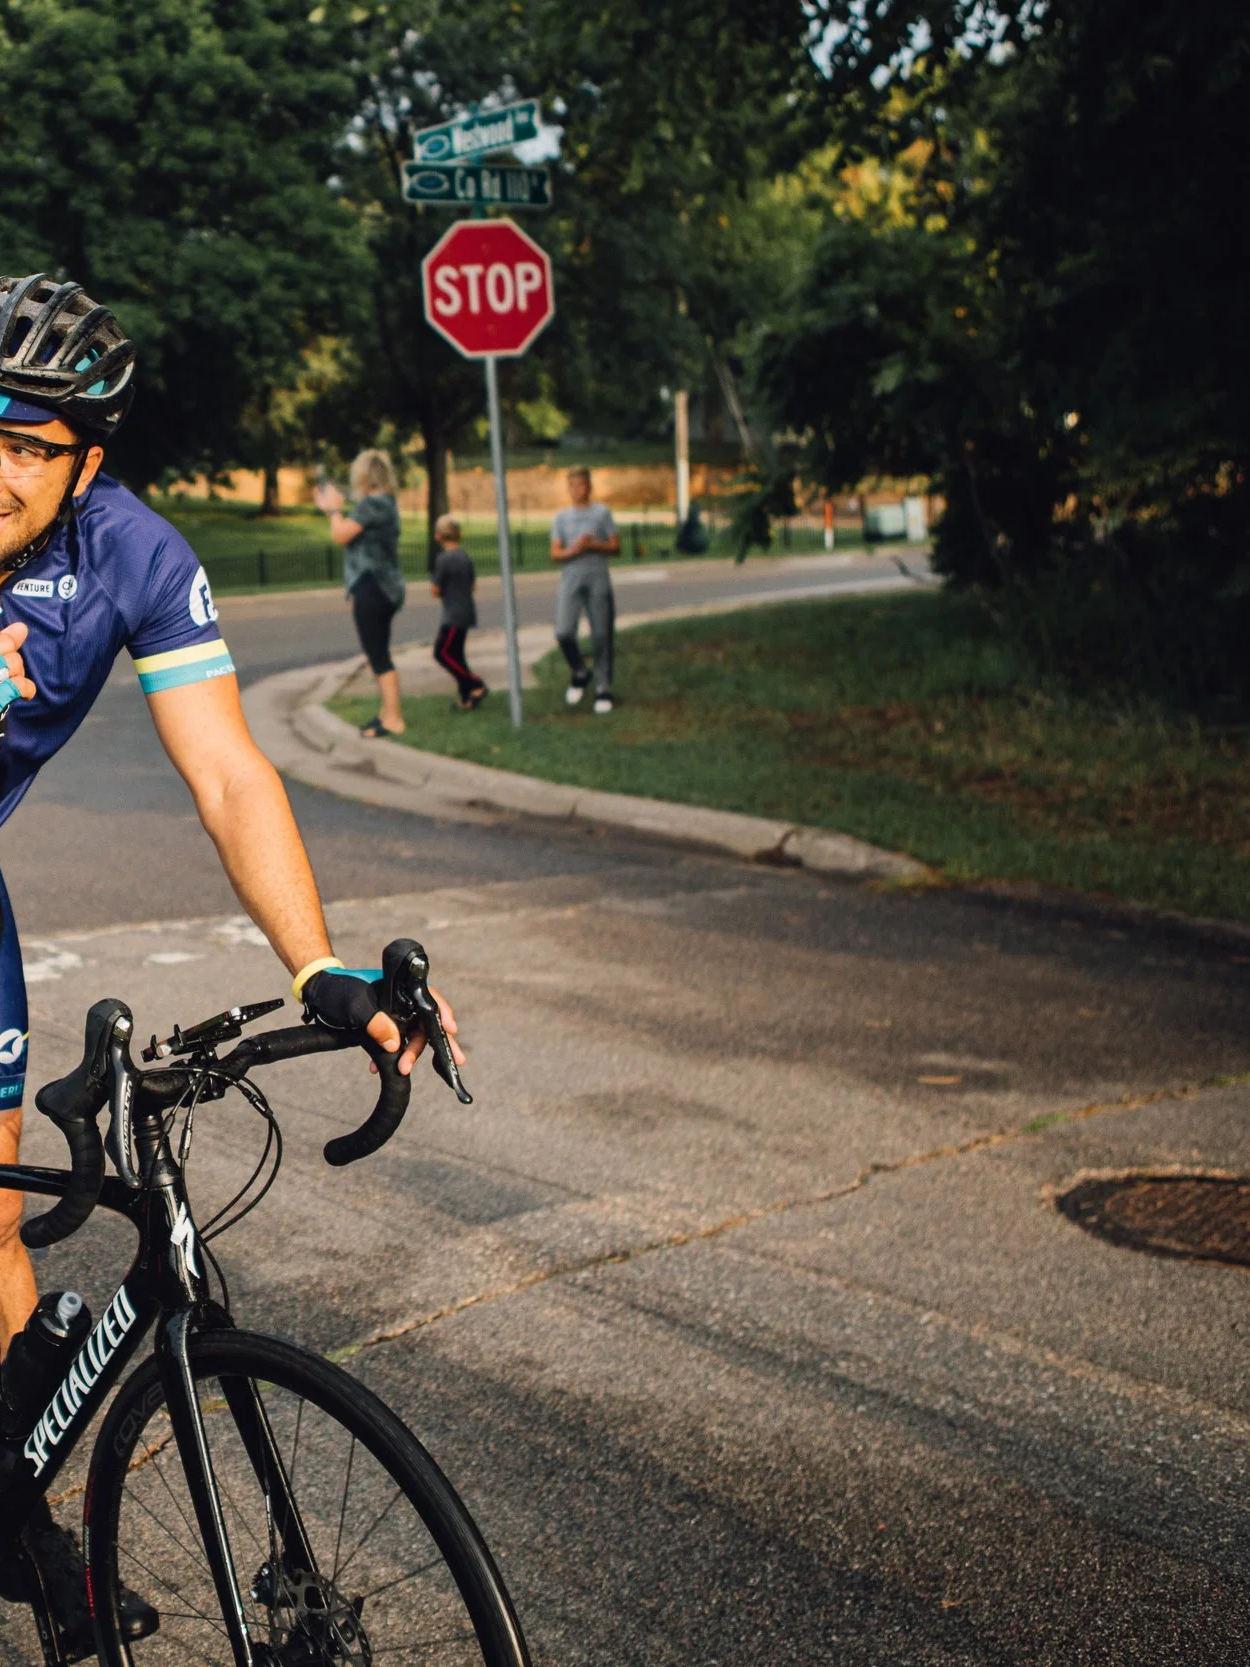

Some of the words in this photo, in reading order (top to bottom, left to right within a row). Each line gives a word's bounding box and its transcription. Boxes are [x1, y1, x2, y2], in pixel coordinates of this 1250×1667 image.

[434, 262, 543, 317] STOP
[16, 582, 50, 593] VENTURE
[24, 1284, 137, 1478] SPECIALIZED
